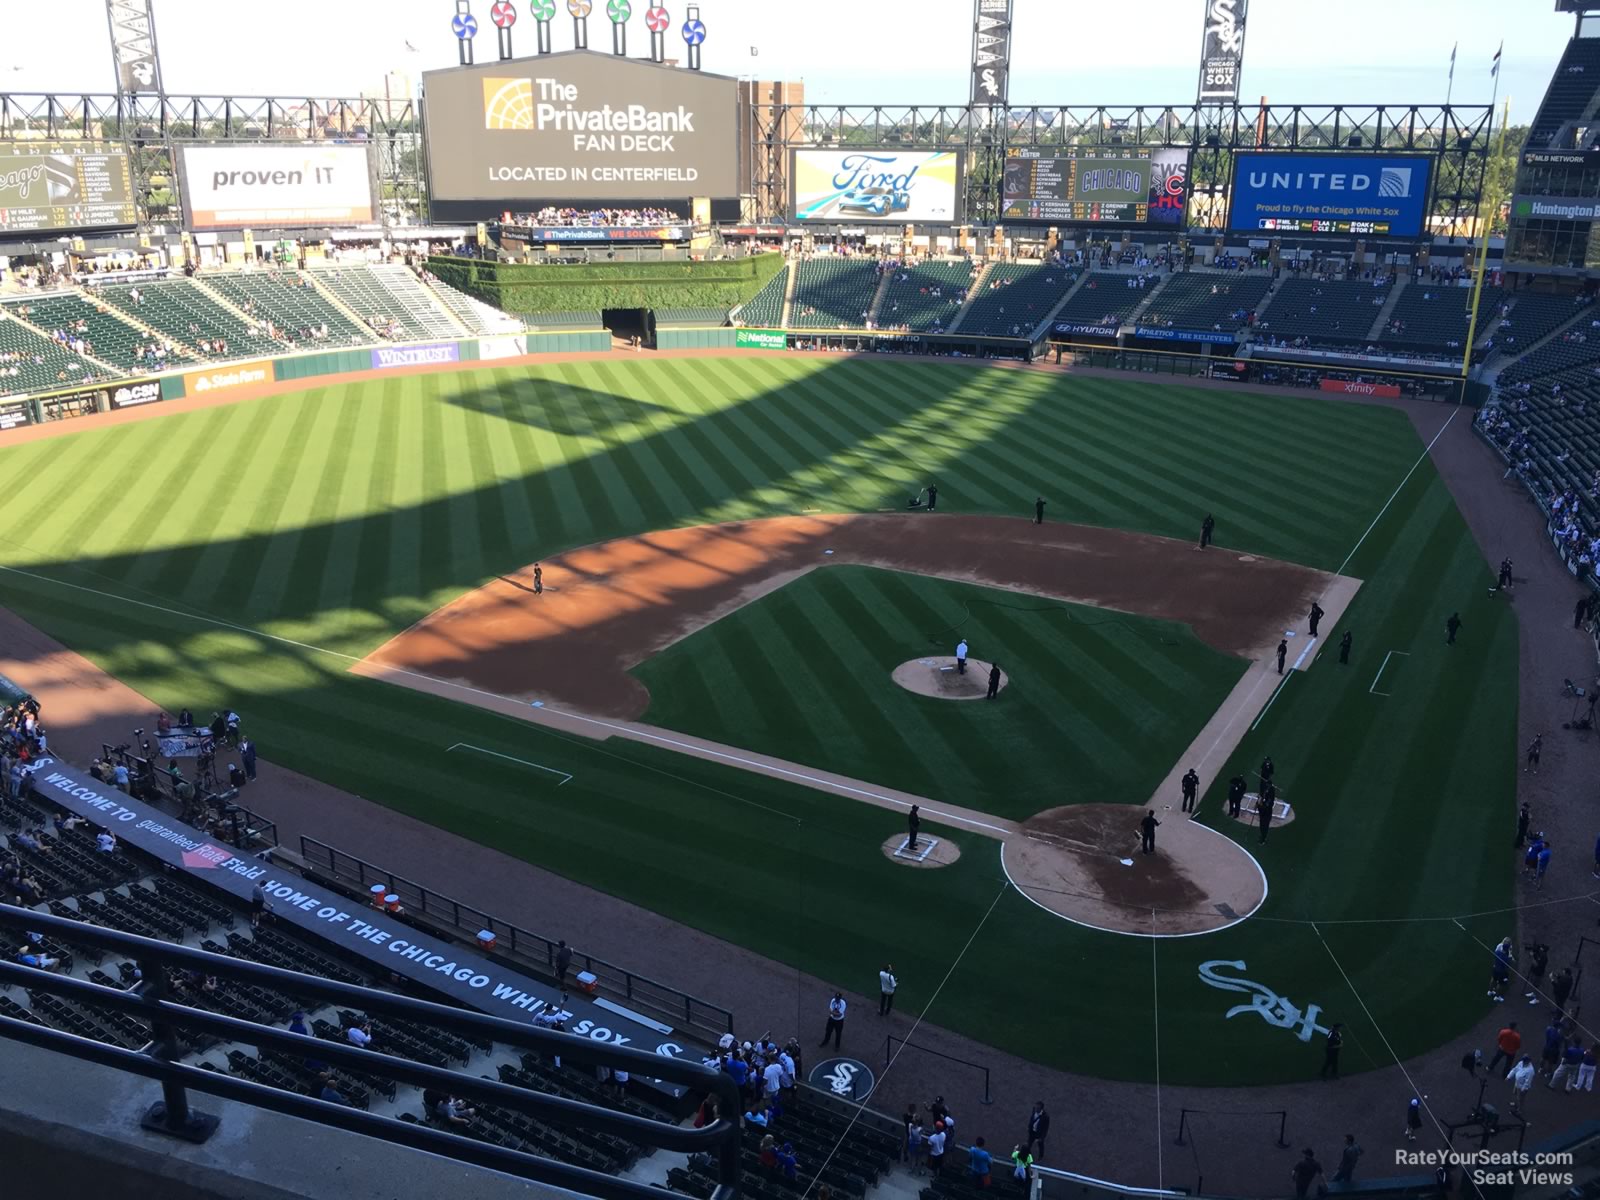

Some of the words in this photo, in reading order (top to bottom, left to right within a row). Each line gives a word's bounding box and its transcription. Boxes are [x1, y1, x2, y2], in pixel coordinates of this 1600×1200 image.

[1206, 74, 1234, 85] SOX
[536, 78, 578, 101] The
[537, 104, 694, 132] PrivateBank
[574, 134, 616, 152] FAN
[621, 134, 674, 152] DECK
[1007, 148, 1019, 158] 34
[212, 169, 302, 190] proven
[315, 167, 334, 184] IT
[489, 167, 567, 181] LOCATED
[571, 167, 588, 181] IN
[592, 167, 698, 182] CENTERFIELD
[832, 154, 919, 192] Ford
[1082, 168, 1141, 193] CHICAGO
[1250, 172, 1371, 191] UNITED
[1256, 204, 1281, 212] Proud
[1282, 204, 1290, 212] to
[1292, 204, 1305, 214] fly
[1306, 205, 1320, 213] the
[1322, 205, 1353, 216] Chicago
[1355, 207, 1381, 215] White
[1383, 208, 1399, 216] Sox
[1532, 202, 1593, 219] Huntington
[551, 231, 605, 239] ThePrivateBank
[748, 332, 785, 343] National
[1072, 325, 1115, 336] HYUNDAI
[1138, 327, 1174, 337] ATHLETICO
[1178, 332, 1191, 340] THE
[1192, 333, 1232, 342] RELIEVERS
[378, 346, 452, 364] WINTRUST
[212, 374, 239, 388] State
[240, 370, 265, 383] Farm
[132, 383, 159, 398] CSN
[1345, 383, 1375, 395] xfinity
[44, 772, 118, 811] WELCOME
[110, 806, 136, 821] TO
[135, 819, 202, 851] guaranteed
[194, 844, 225, 863] Rate
[220, 857, 267, 879] Field
[264, 880, 320, 911] HOME
[316, 907, 350, 922] OF
[346, 919, 392, 944] THE
[388, 940, 490, 988] CHICAGO
